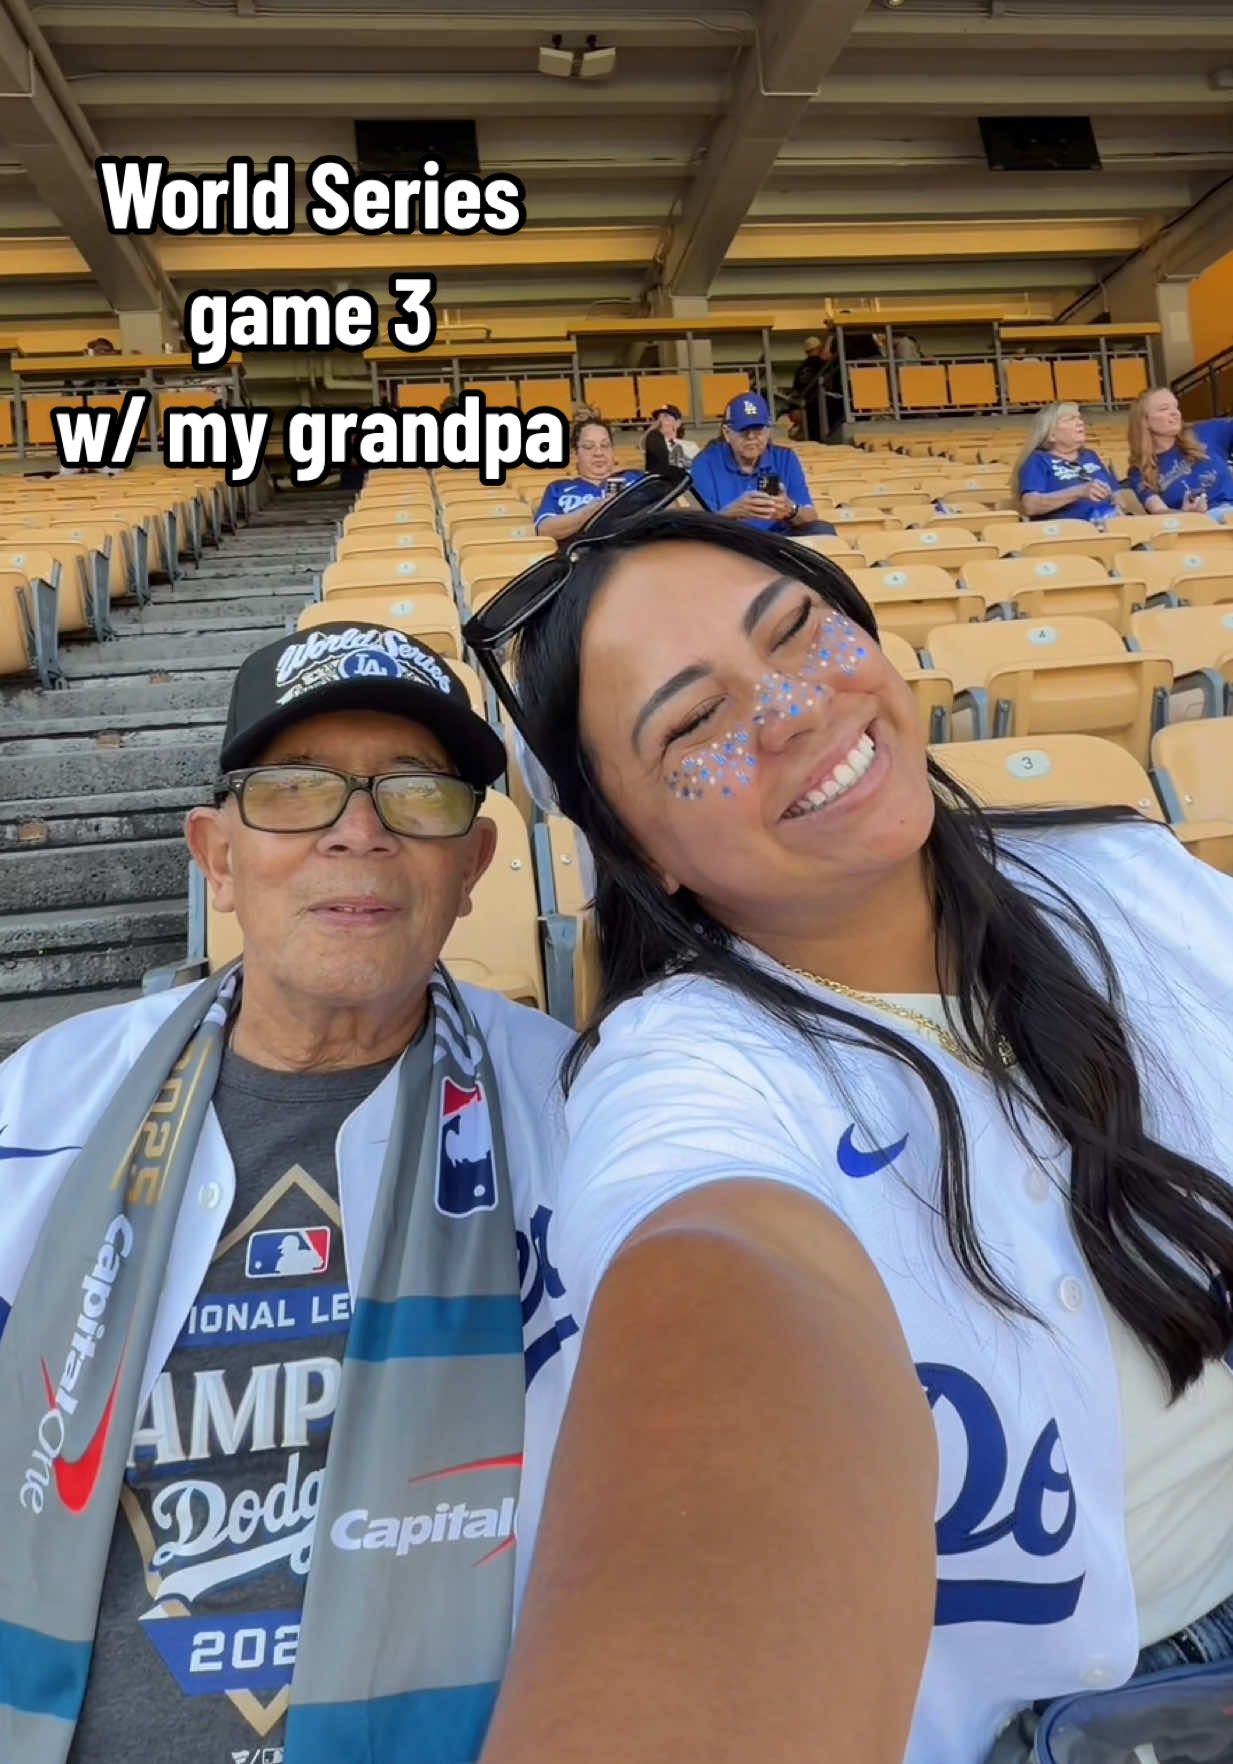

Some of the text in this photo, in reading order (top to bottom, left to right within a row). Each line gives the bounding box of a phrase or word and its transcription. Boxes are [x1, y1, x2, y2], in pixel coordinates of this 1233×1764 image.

[743, 400, 758, 415] LA
[276, 628, 380, 688] World
[384, 630, 452, 695] Series
[354, 653, 389, 677] LA
[1021, 756, 1035, 771] 3
[311, 1292, 350, 1324] LE
[19, 1213, 134, 1515] Capital One
[330, 1496, 515, 1556] Capital
[189, 1624, 302, 1673] 202
